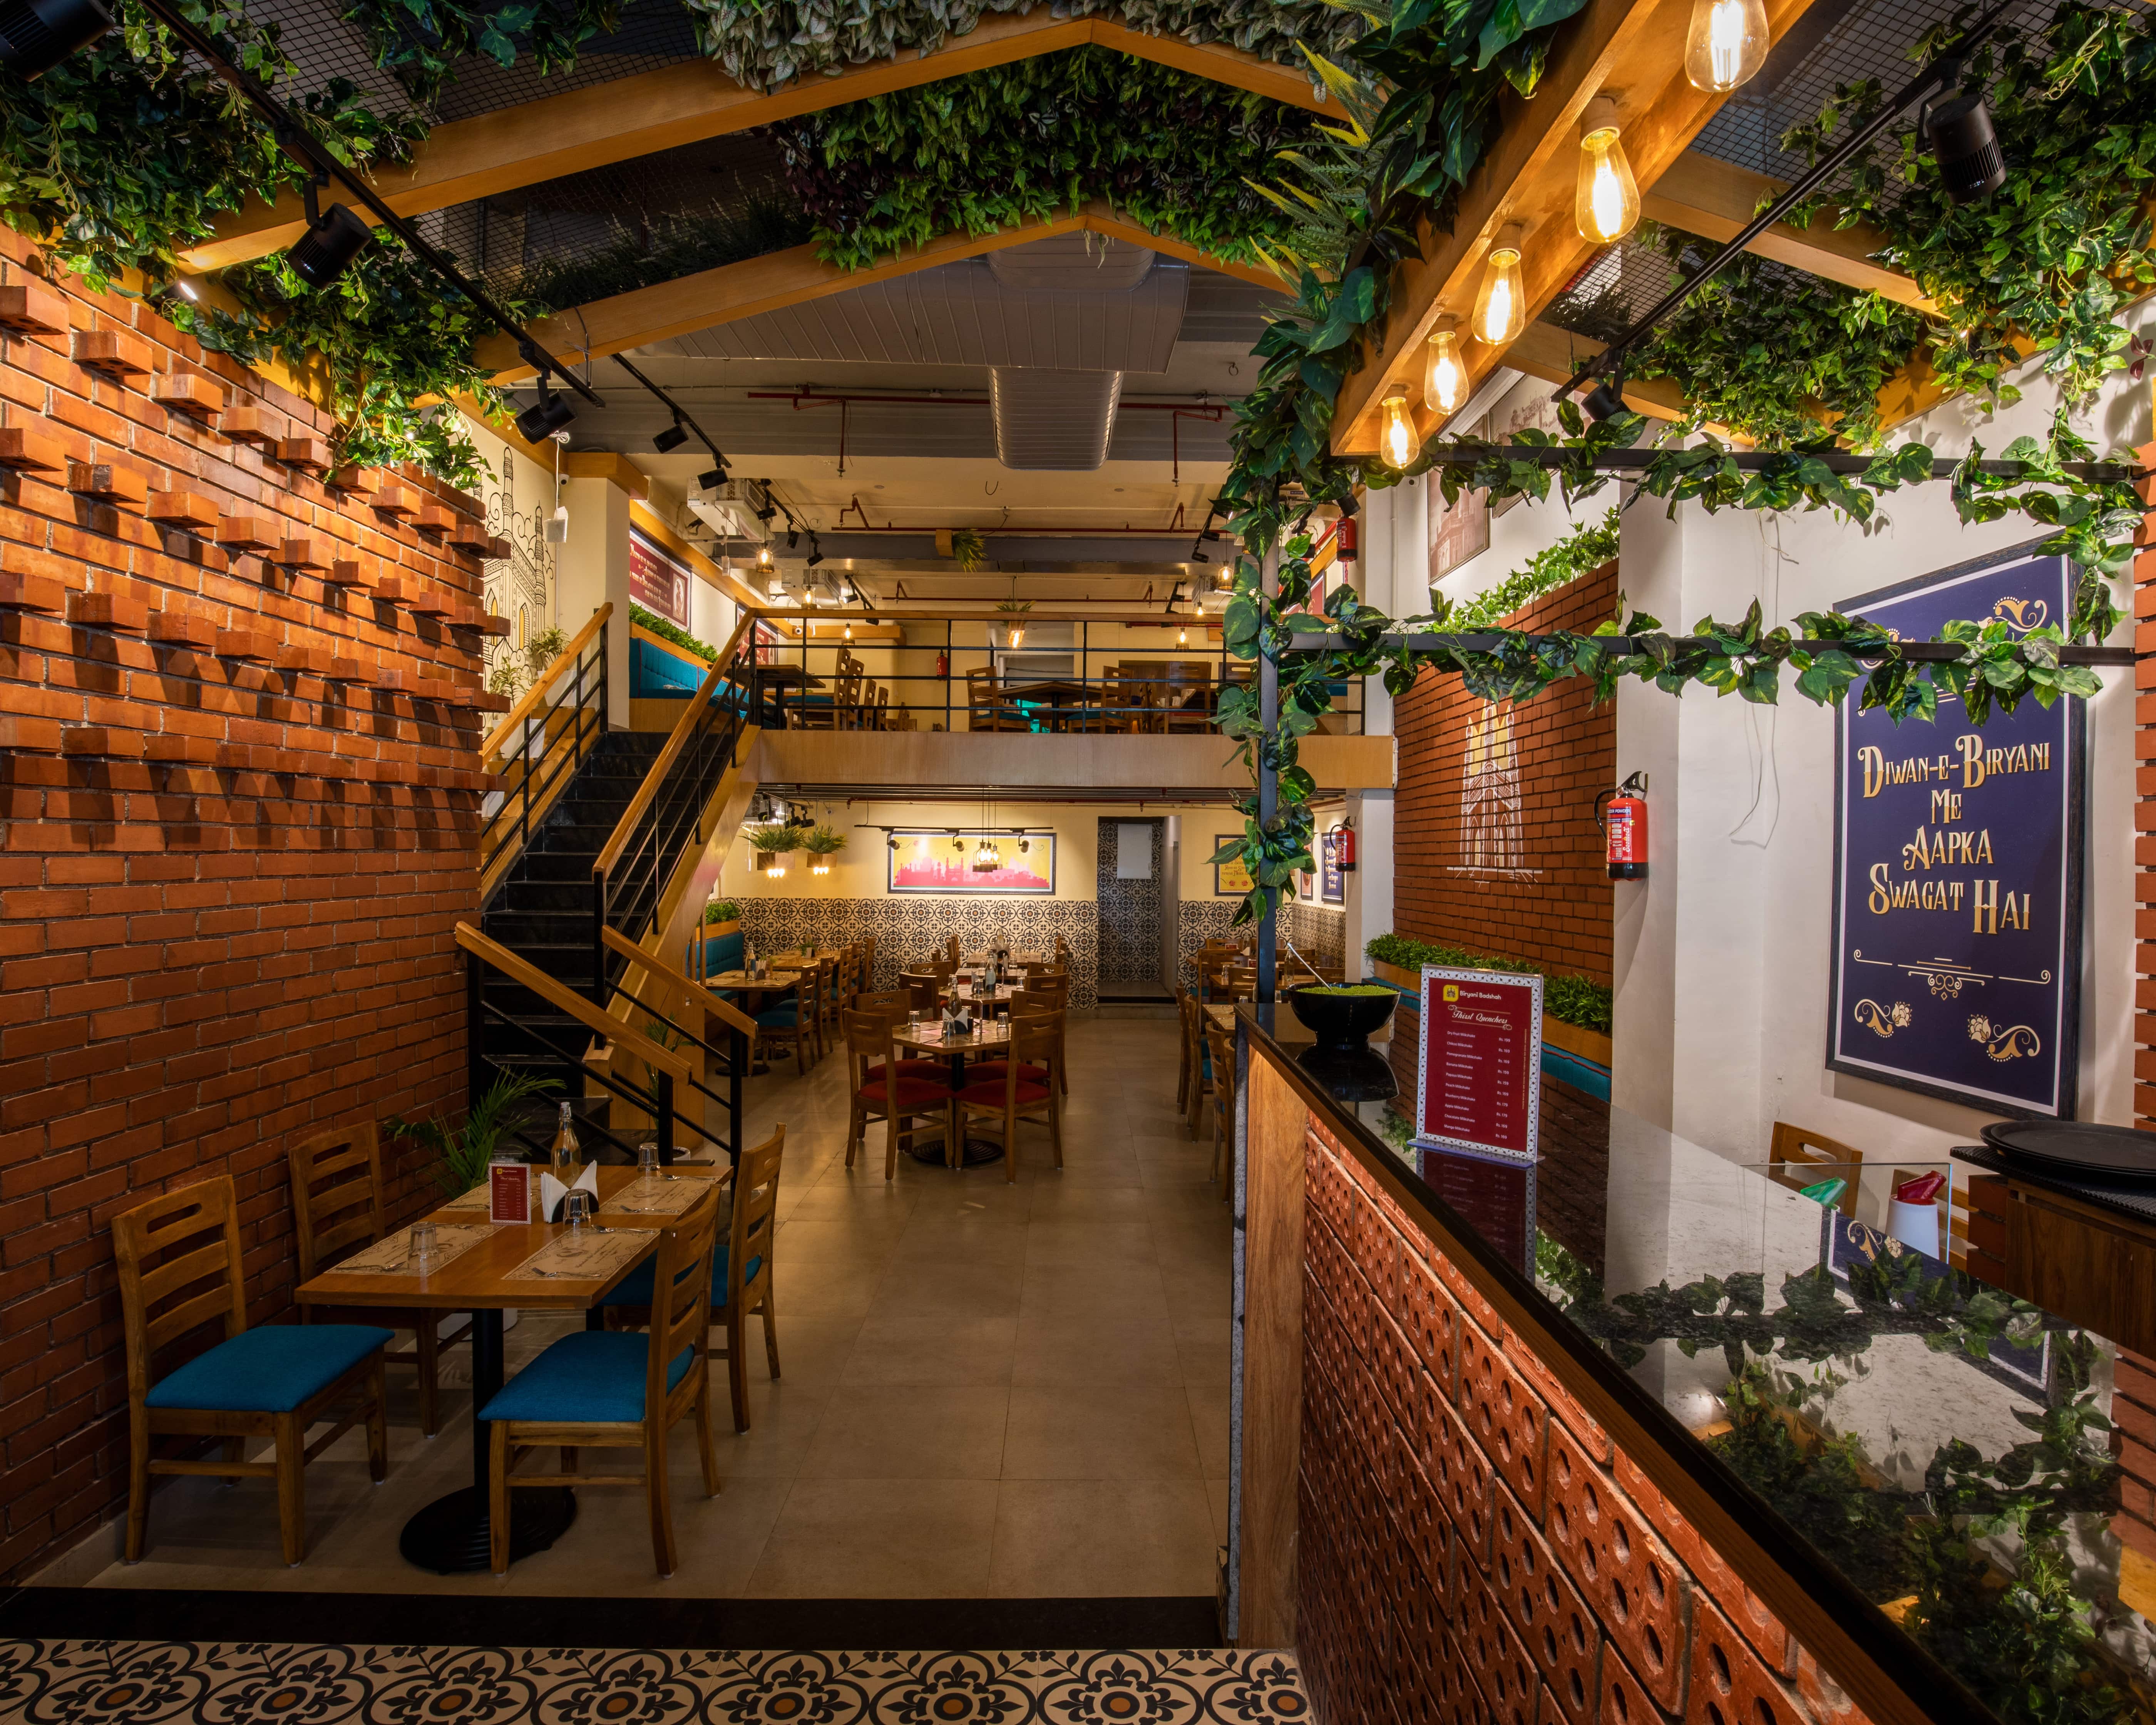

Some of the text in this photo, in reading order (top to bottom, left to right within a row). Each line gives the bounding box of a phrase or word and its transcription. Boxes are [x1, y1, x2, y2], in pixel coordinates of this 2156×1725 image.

[1931, 788, 1962, 824] ME
[1902, 825, 1994, 871] AAPKA
[1868, 862, 2030, 934] SWAGAT HAI
[1452, 1011, 1507, 1023] Thirst Quenchers
